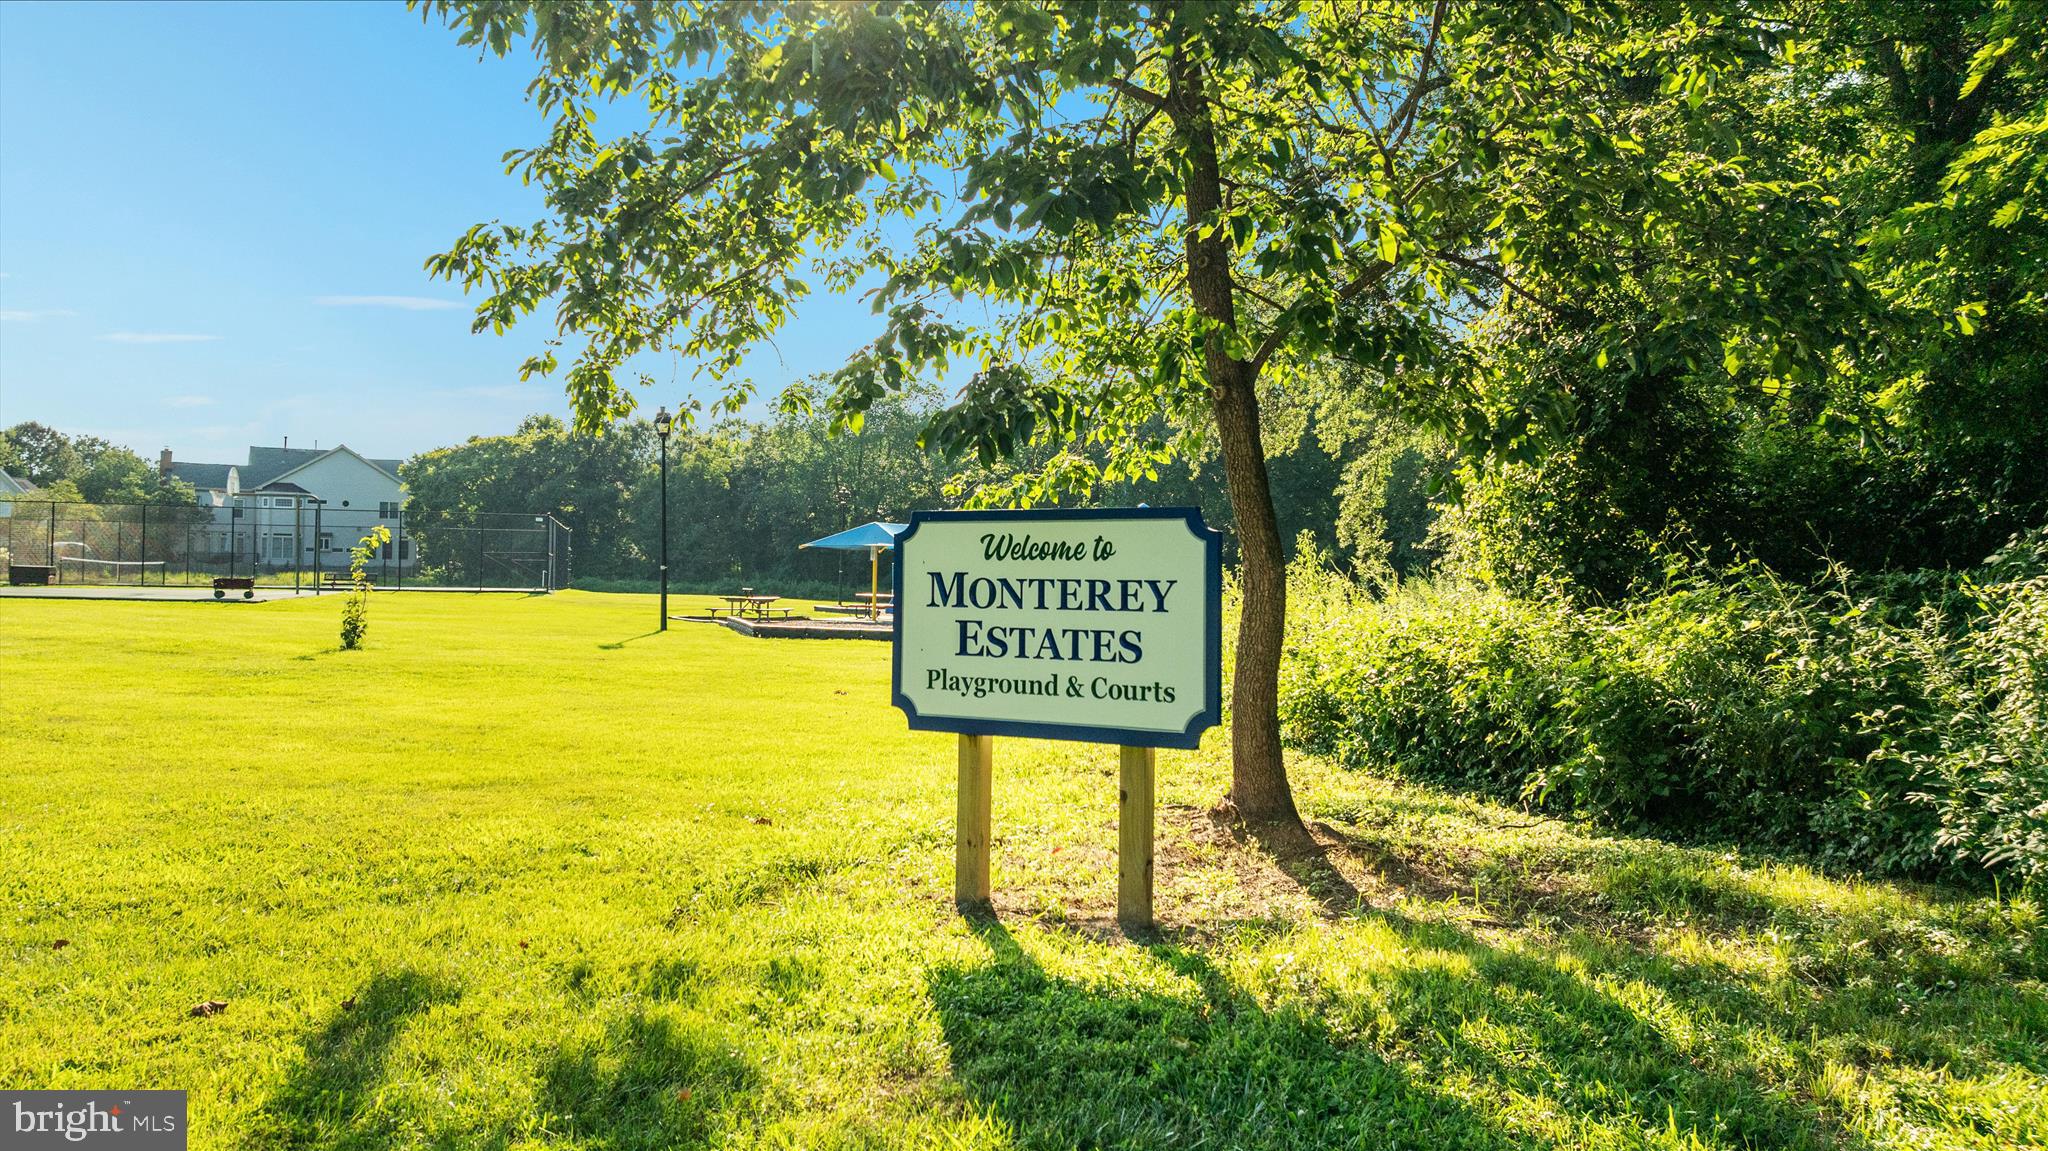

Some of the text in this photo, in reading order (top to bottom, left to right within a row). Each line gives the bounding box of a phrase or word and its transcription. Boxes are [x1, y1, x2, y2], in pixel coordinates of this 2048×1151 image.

[980, 533, 1116, 562] Welcome to
[926, 571, 1178, 613] MONTEREY
[954, 620, 1143, 664] ESTATES
[926, 668, 1176, 703] Playground & Courts
